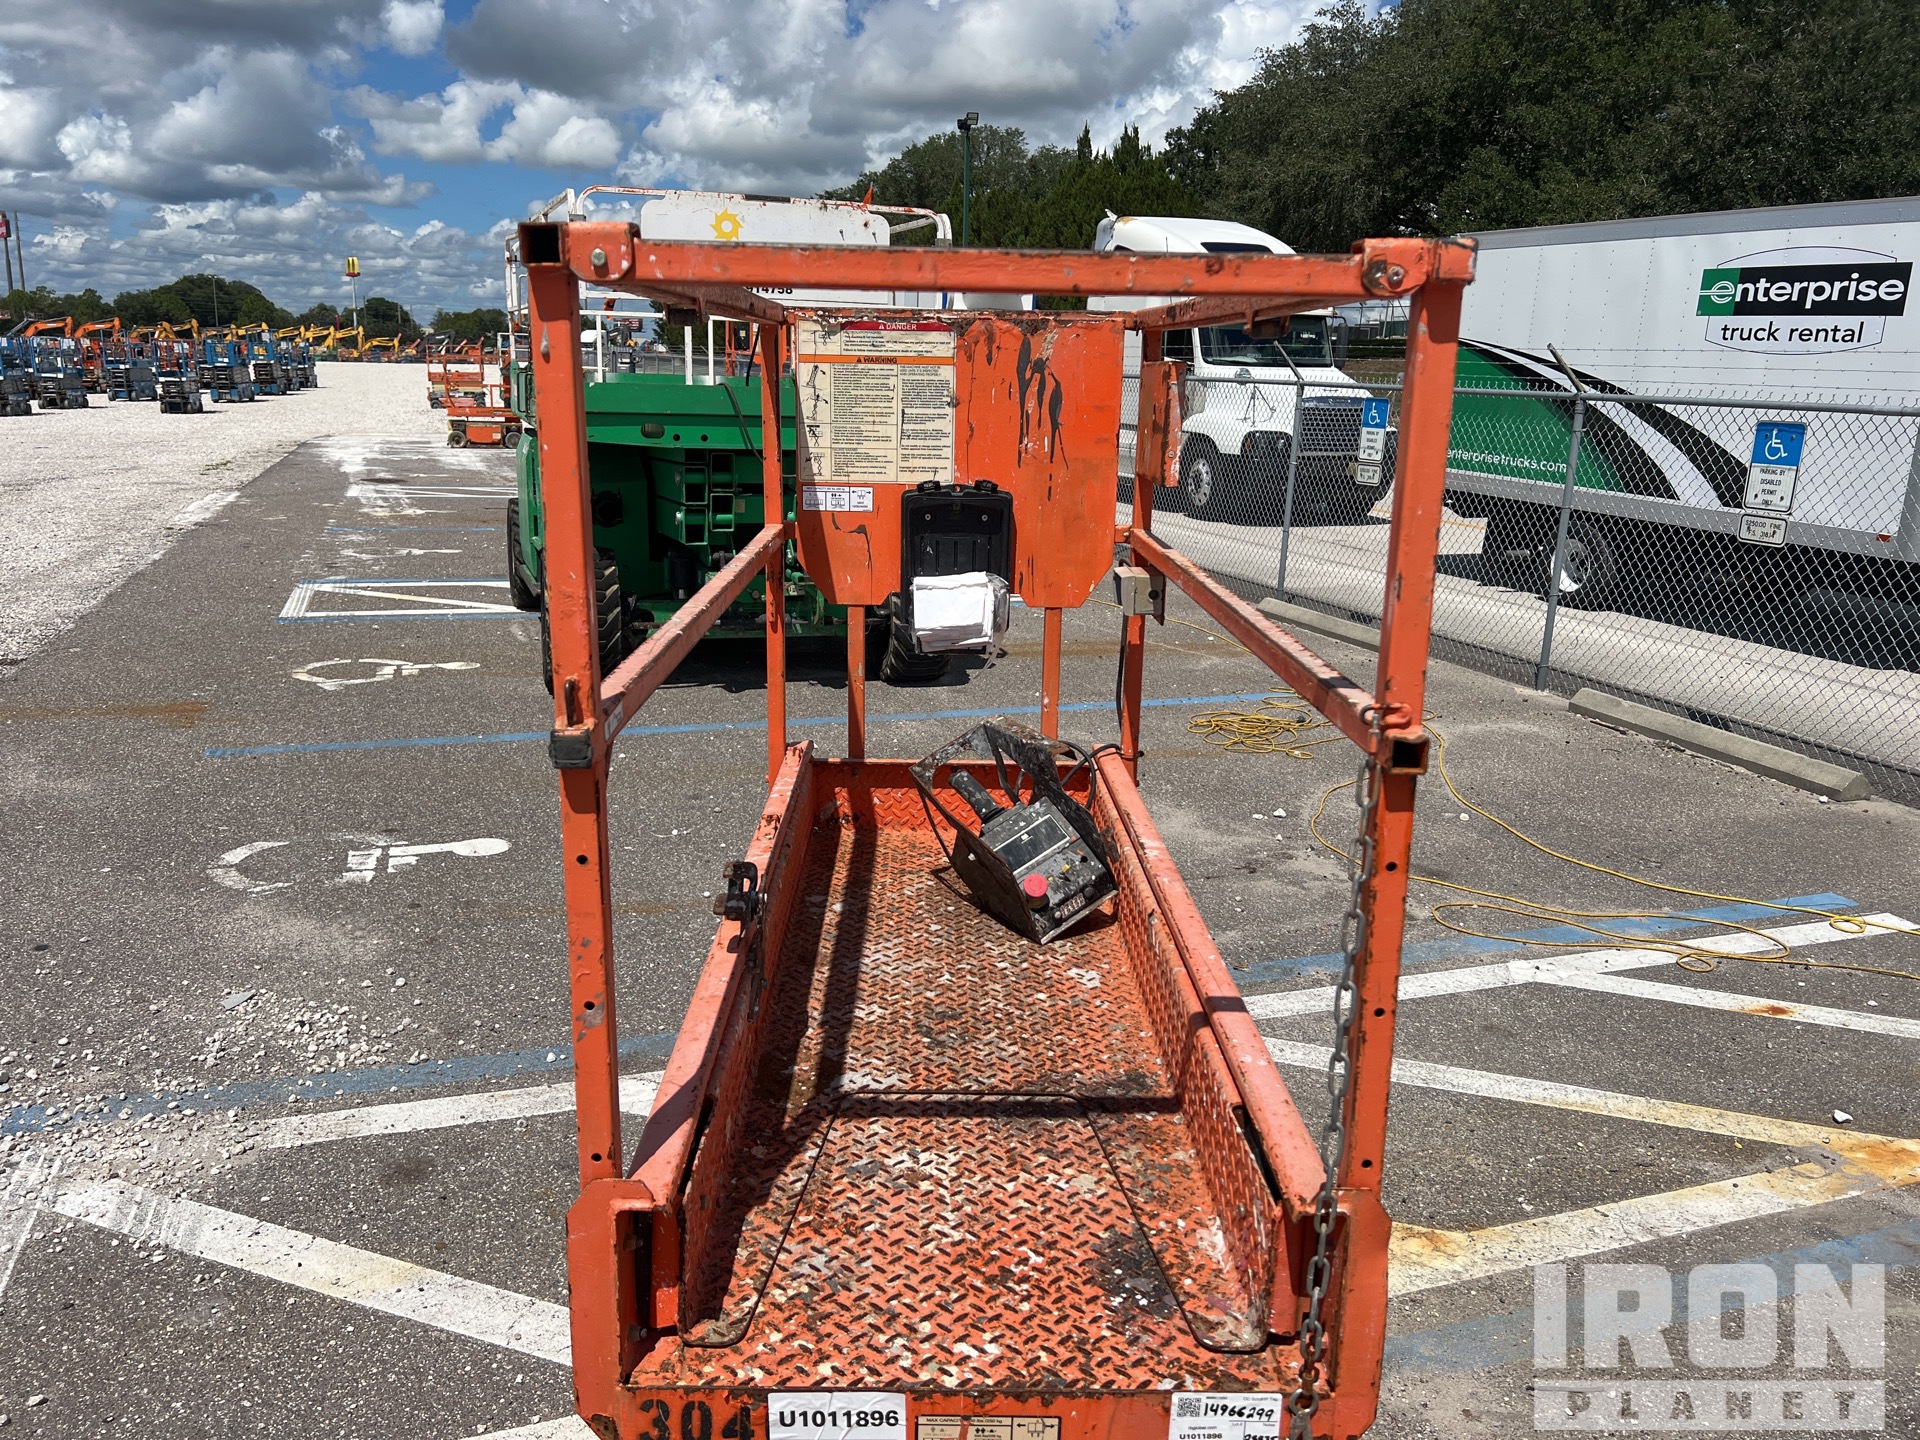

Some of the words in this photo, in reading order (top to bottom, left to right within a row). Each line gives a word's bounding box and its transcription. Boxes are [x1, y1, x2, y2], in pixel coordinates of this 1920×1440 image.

[1700, 273, 1905, 309] enterprise
[886, 323, 917, 331] DANGER
[1721, 321, 1781, 342] truck
[1788, 321, 1864, 343] rental
[863, 356, 897, 364] WARNING
[1447, 449, 1567, 473] enterprisetrucks.com
[1761, 488, 1777, 496] PERMIT
[1761, 498, 1773, 506] ONLY
[1769, 523, 1782, 531] FINE
[779, 1410, 899, 1428] U1011896
[1204, 1403, 1275, 1422] 14966299
